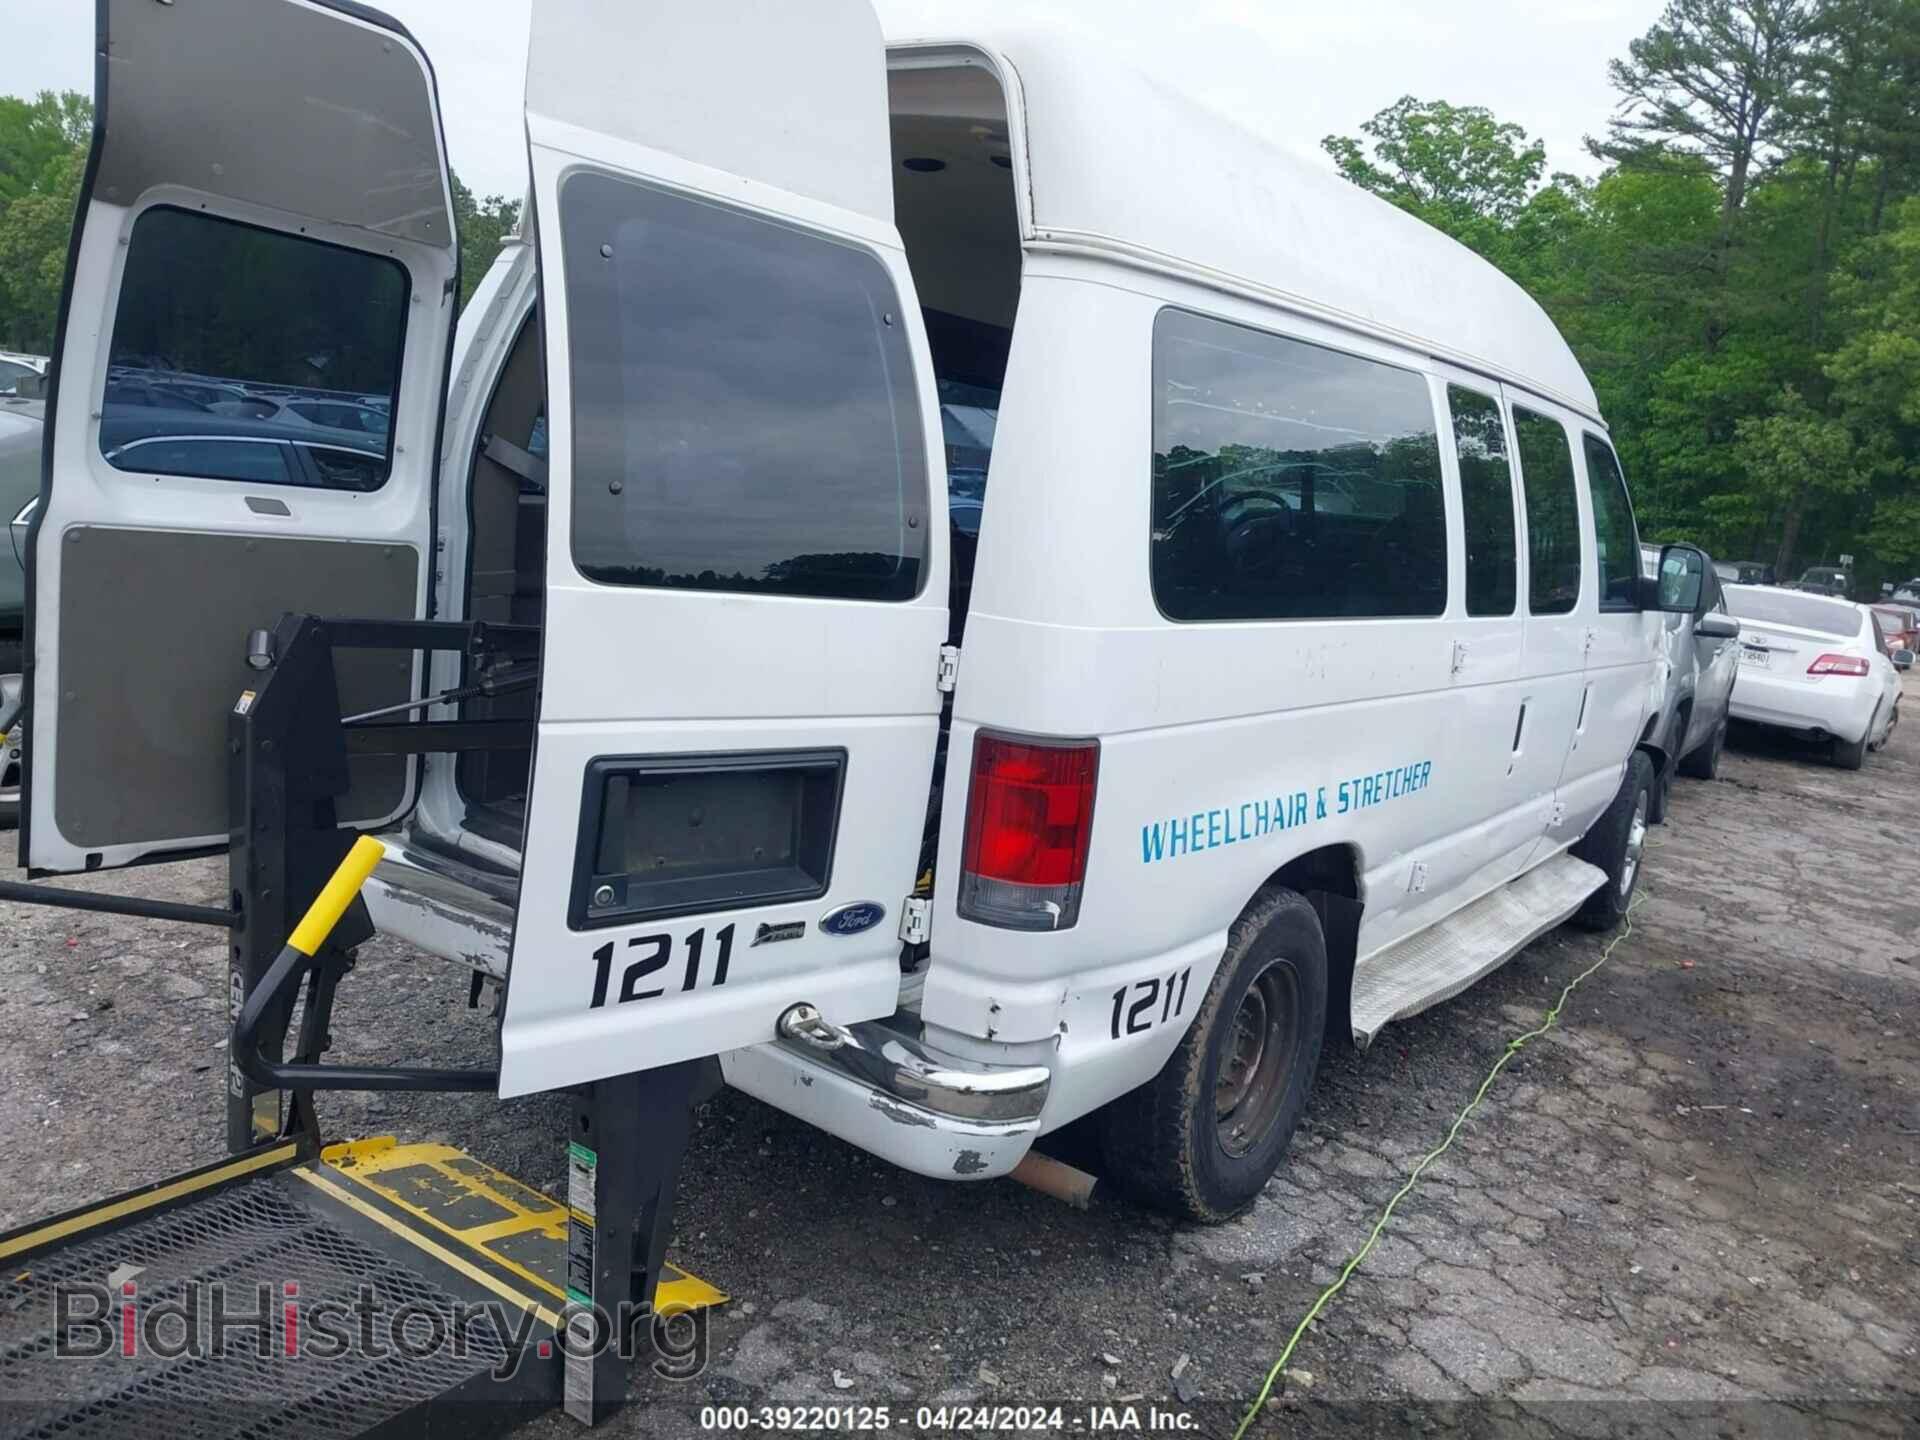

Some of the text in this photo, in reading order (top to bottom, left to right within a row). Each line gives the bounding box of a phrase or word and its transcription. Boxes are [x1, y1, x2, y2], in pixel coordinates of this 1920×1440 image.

[1141, 761, 1432, 863] WHEELCHAIR & STRETCHER
[837, 907, 873, 929] Ford
[589, 922, 736, 1009] 1211
[1110, 966, 1192, 1040] 1211
